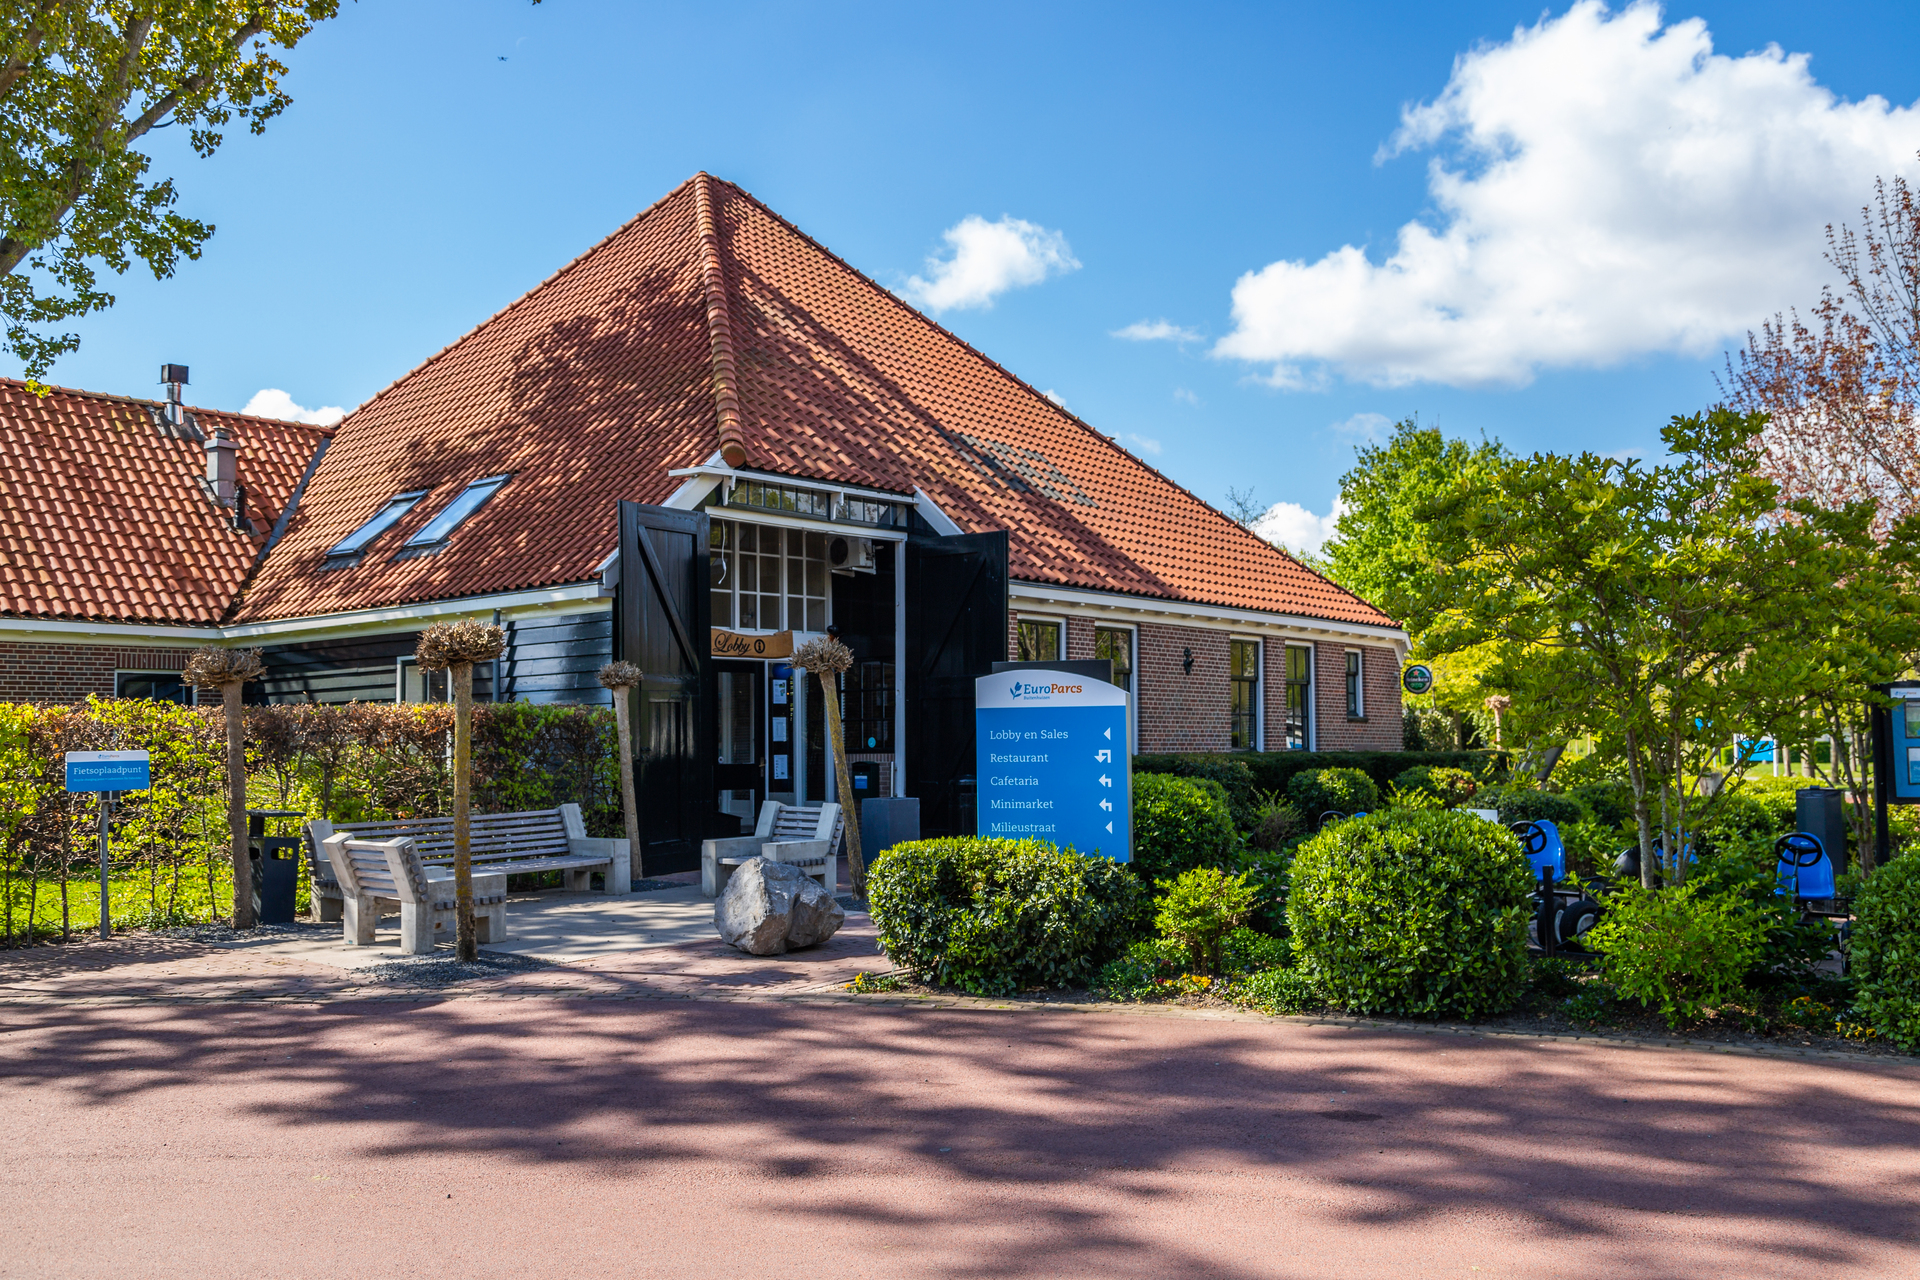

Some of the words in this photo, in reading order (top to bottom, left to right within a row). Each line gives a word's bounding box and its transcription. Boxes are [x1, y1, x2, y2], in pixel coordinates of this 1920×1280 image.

[713, 633, 751, 656] Lobby
[1023, 683, 1083, 695] EuroParcs
[990, 729, 1021, 742] Lobby
[1024, 731, 1038, 740] en
[1040, 729, 1069, 739] Sales
[990, 753, 1049, 763] Restaurant
[73, 766, 142, 776] Fietsoplaadpunt
[990, 776, 1039, 786] Cafetaria
[990, 799, 1054, 809] Minimarket
[991, 822, 1056, 832] Milieustraat
